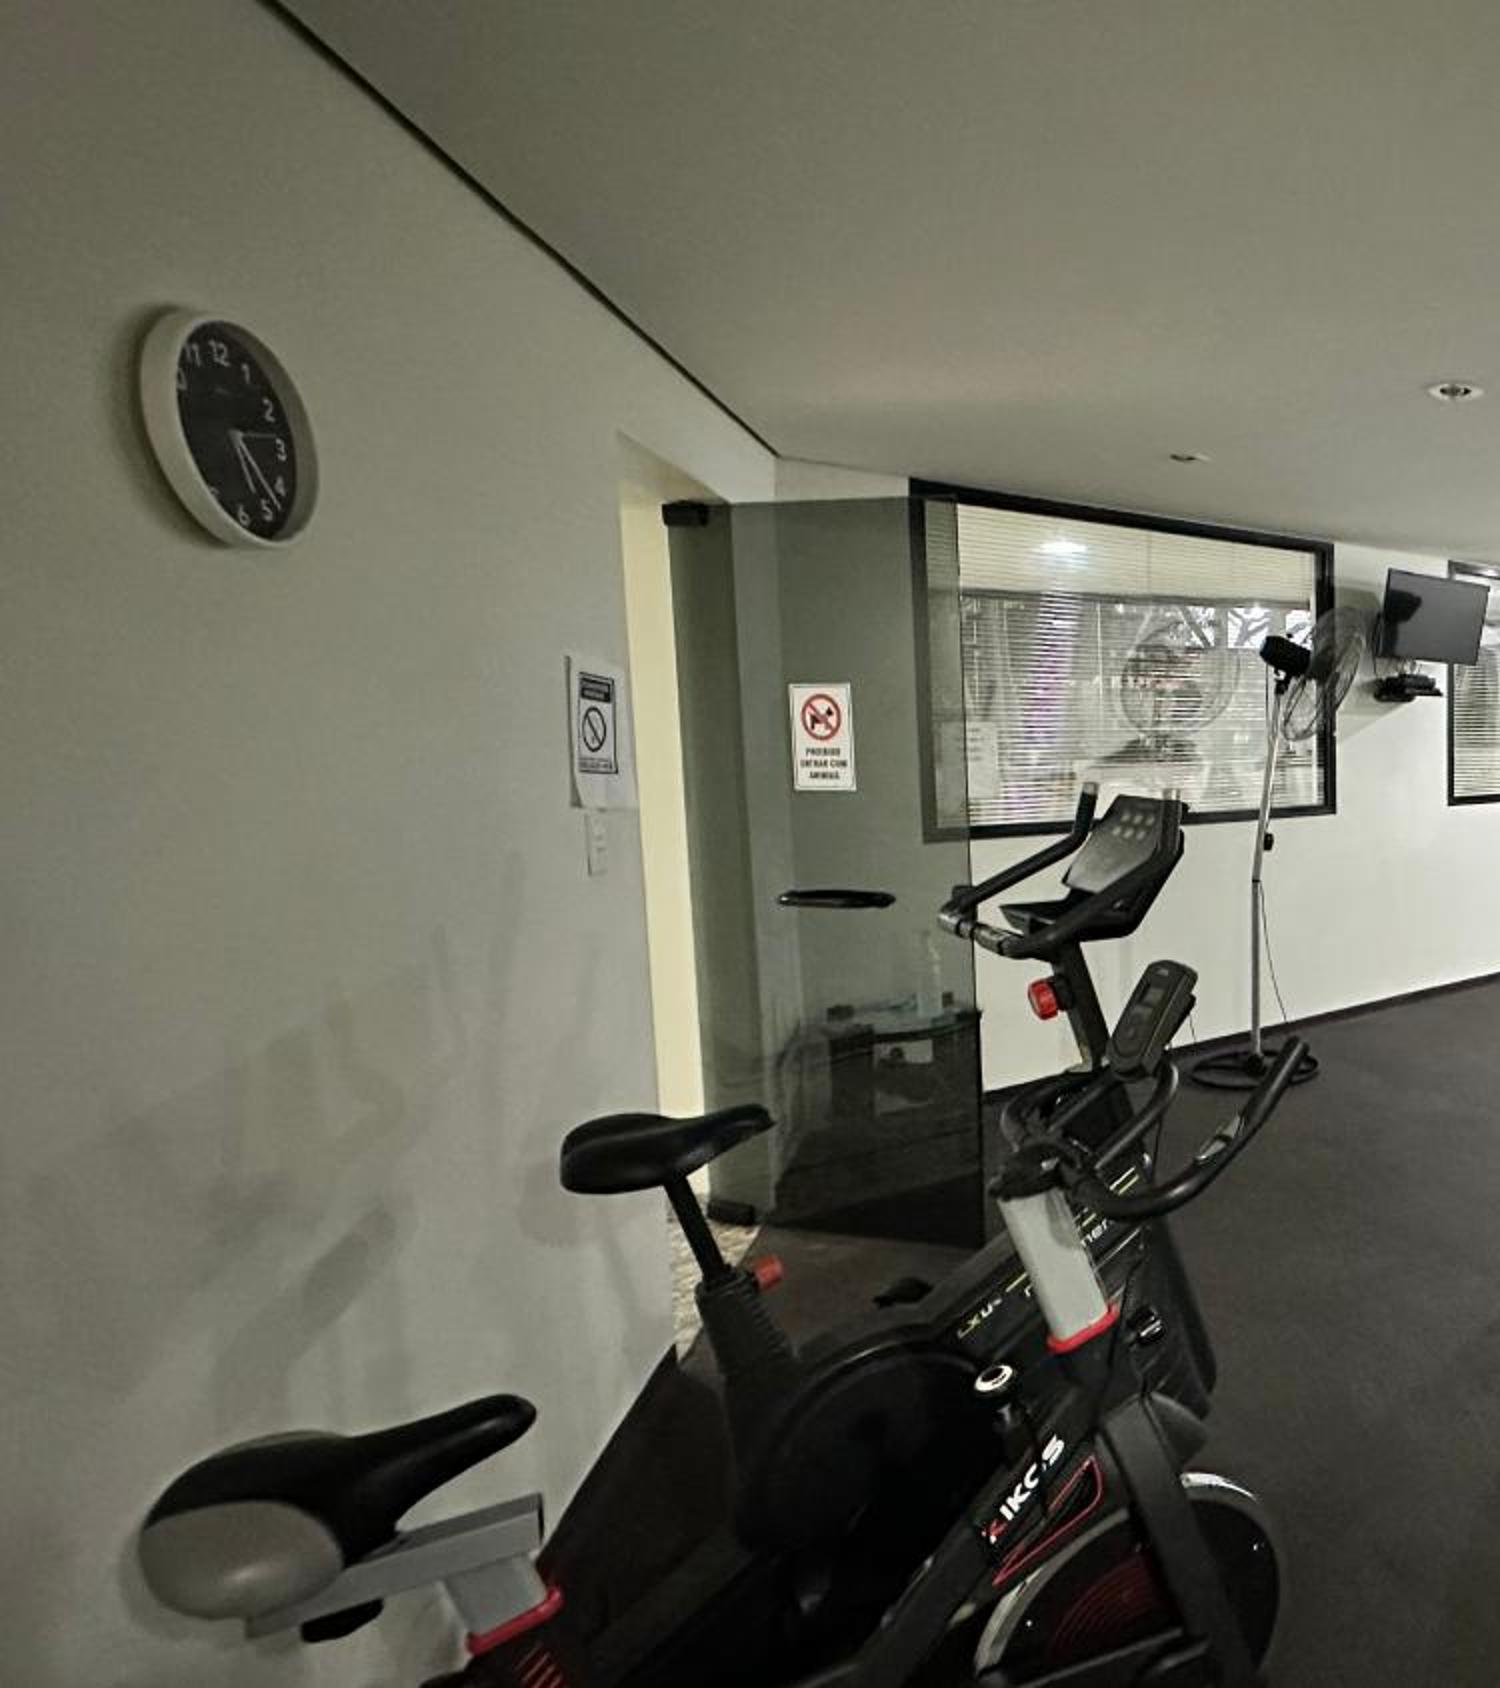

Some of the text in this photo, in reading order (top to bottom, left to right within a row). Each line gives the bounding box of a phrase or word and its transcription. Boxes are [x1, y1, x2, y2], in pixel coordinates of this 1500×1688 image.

[185, 343, 202, 368] 11
[208, 340, 230, 367] 12
[241, 363, 251, 385] 1
[262, 398, 276, 423] 2
[275, 438, 288, 461] 3
[236, 503, 251, 526] 6
[260, 500, 274, 521] 5
[800, 759, 848, 768] ENTRAR COM
[805, 747, 841, 757] PROIBIDO
